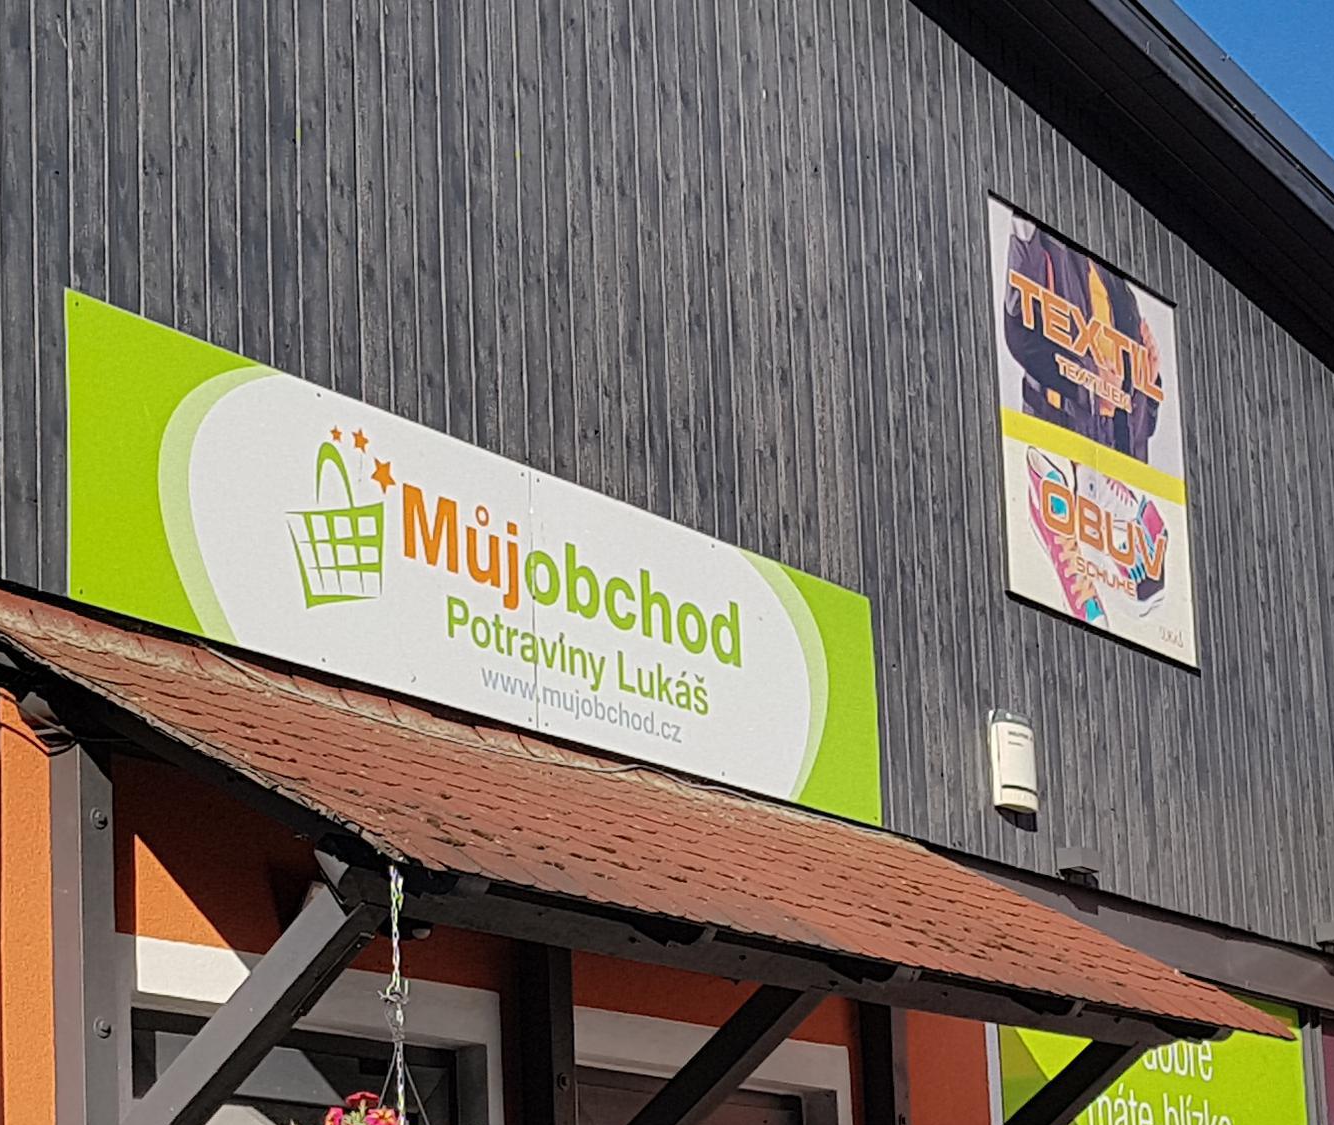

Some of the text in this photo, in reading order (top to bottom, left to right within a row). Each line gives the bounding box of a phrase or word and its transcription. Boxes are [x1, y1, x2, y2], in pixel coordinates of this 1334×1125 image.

[1009, 269, 1164, 402] TEXTIL
[402, 483, 743, 668] Můjobchod
[1041, 478, 1166, 581] OBUV
[1076, 556, 1136, 598] SCHUHE
[447, 595, 710, 716] Potraviny Lukáš
[481, 668, 683, 743] www.mujobchod.cz
